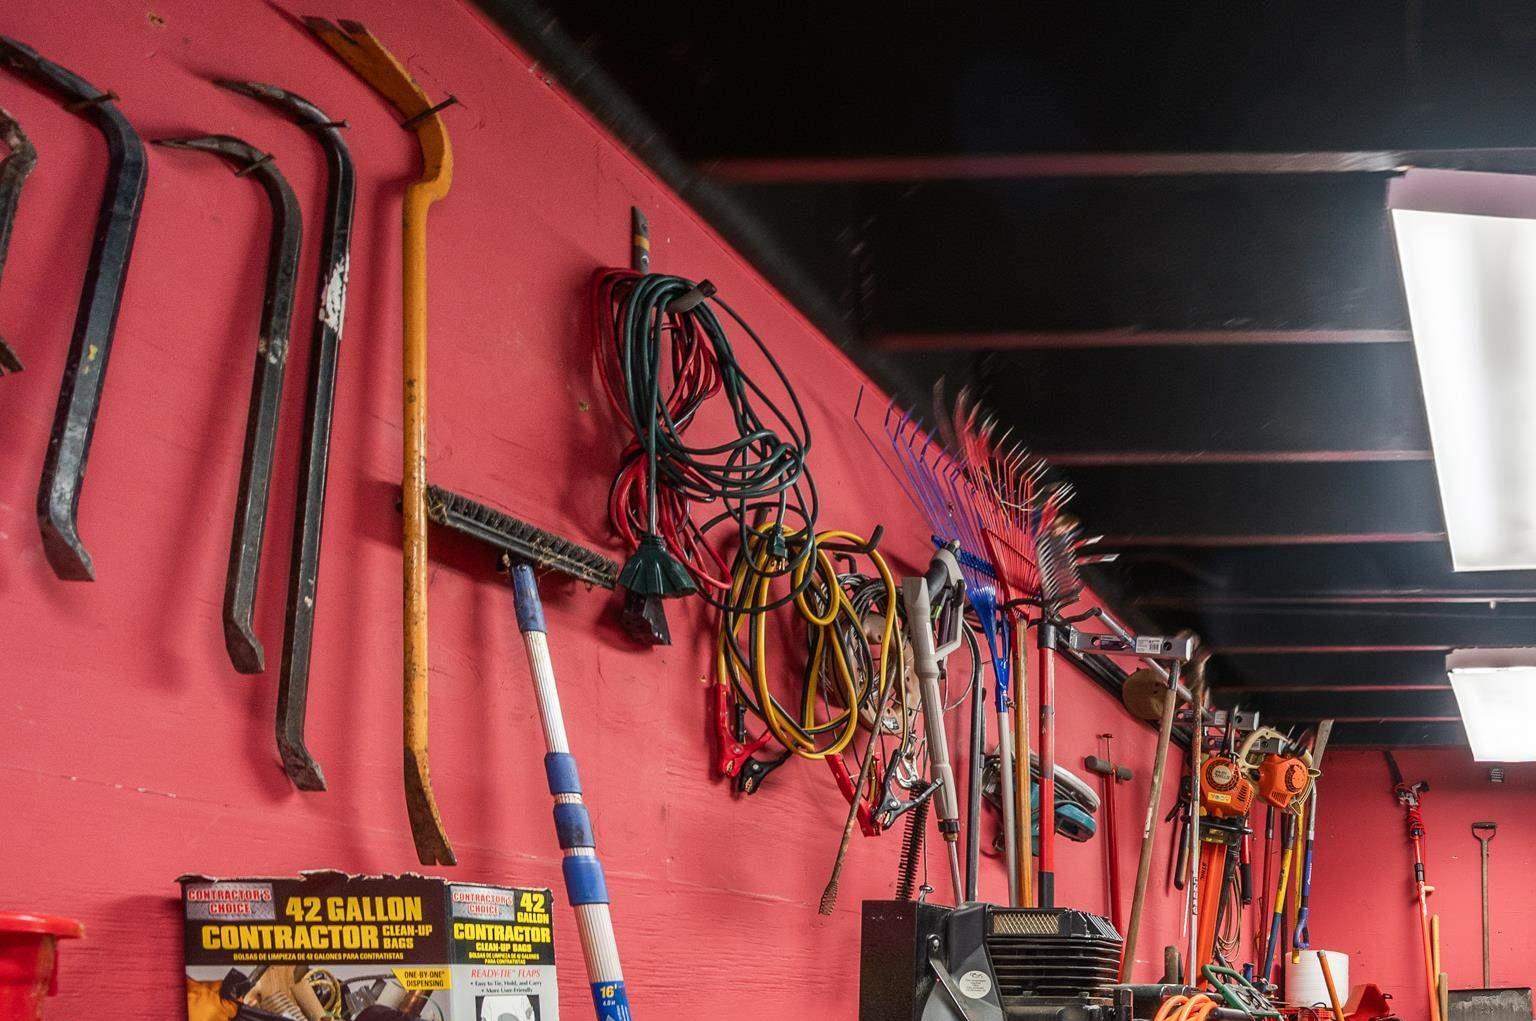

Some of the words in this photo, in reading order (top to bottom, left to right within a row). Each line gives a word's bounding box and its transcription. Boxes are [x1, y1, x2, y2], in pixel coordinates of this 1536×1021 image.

[187, 888, 272, 902] CONTRACTOR'S
[452, 892, 513, 906] CONTRACTOR'S
[209, 902, 251, 914] CHOICE
[520, 893, 545, 912] 42
[286, 896, 322, 922] 42
[327, 896, 422, 922] GALLON
[468, 904, 499, 915] CHOICE
[517, 911, 550, 924] GALLON
[382, 925, 432, 937] CLEAN-UP
[453, 923, 551, 943] CONTRACTOR
[202, 925, 379, 950] CONTRACTOR
[383, 938, 414, 949] BAGS
[475, 942, 511, 952] CLEAN-UP
[512, 943, 532, 952] BAGS
[233, 952, 257, 961] BOLSAS
[259, 952, 266, 961] DE
[268, 952, 296, 961] LIMPIEZA
[298, 952, 306, 961] DE
[306, 952, 313, 961] 42
[314, 952, 342, 961] GALONES
[342, 952, 358, 961] PARA
[360, 952, 404, 961] CONTRATISTAS
[518, 969, 541, 978] FLAPS
